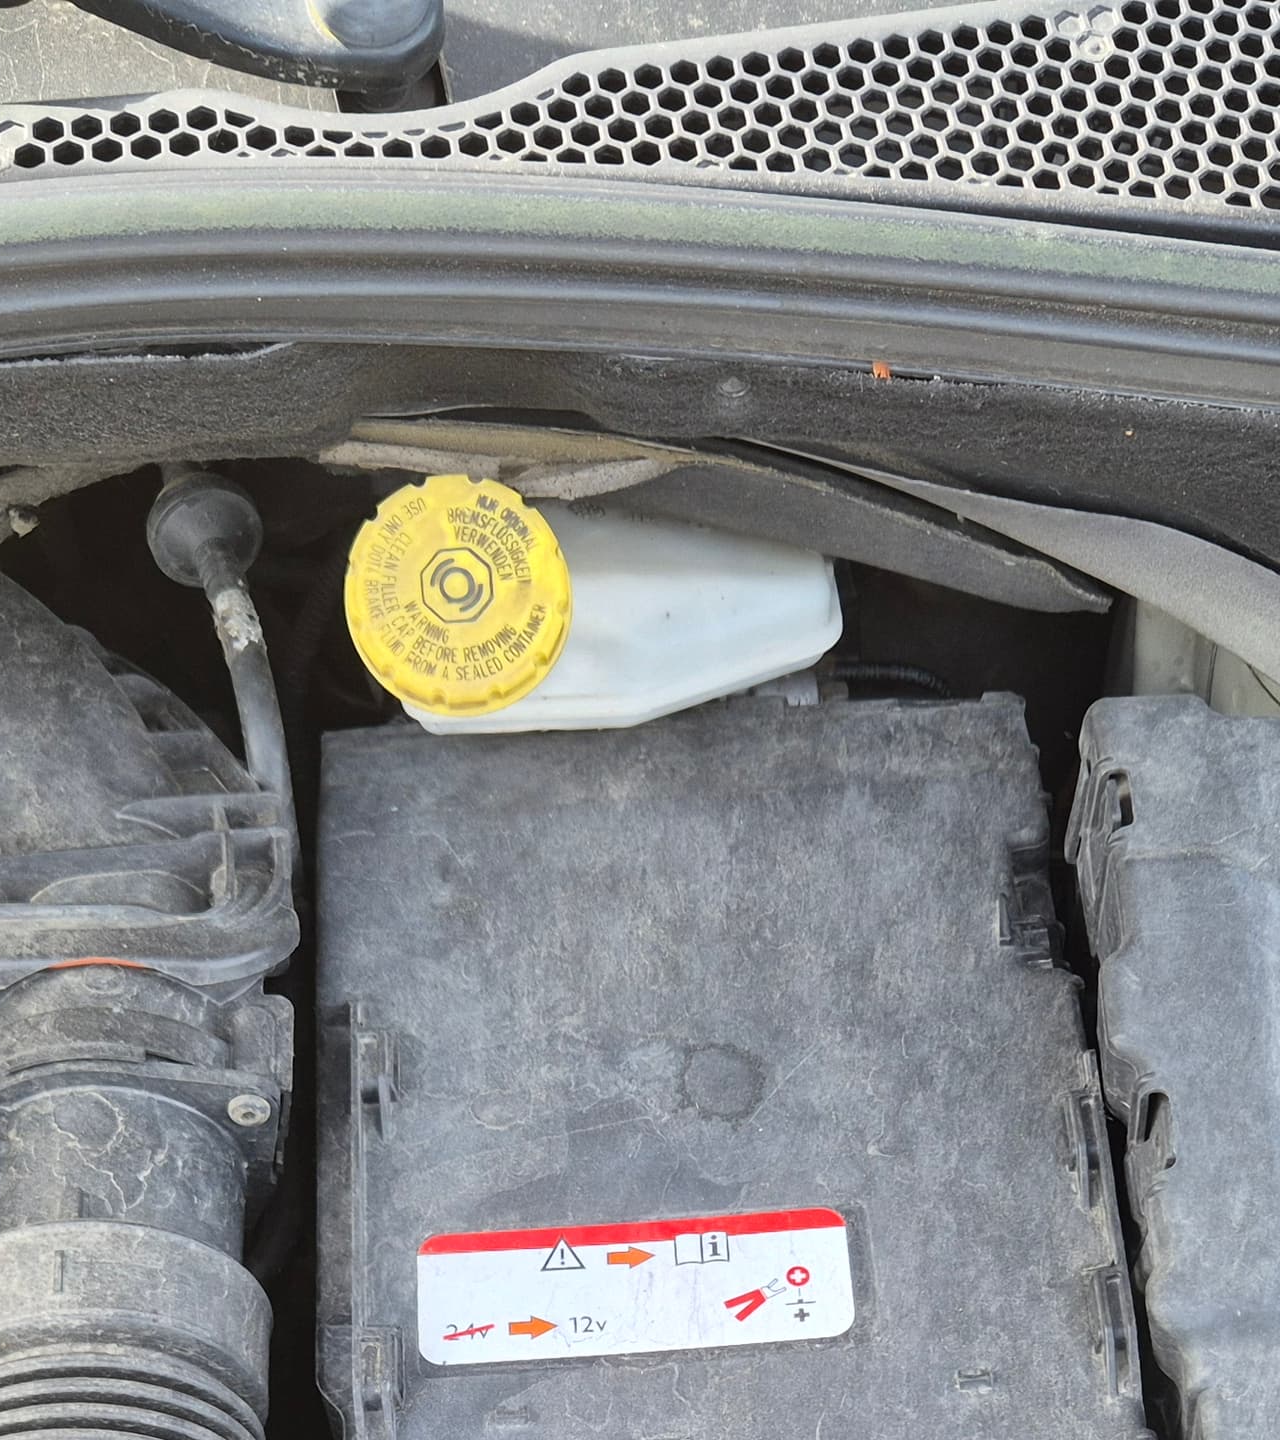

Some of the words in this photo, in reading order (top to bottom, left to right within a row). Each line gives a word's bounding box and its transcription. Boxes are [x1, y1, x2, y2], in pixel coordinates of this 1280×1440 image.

[402, 497, 426, 519] USE
[377, 514, 403, 544] ONLY
[383, 532, 411, 571] CLEAN
[453, 525, 512, 580] VERWENDEN
[381, 575, 400, 613] FILLER
[392, 615, 414, 638] CAP
[404, 600, 448, 644] WARNING
[503, 604, 545, 663] CONTAINER
[412, 635, 457, 663] BEFORE
[463, 624, 517, 662] REMOVING
[455, 656, 503, 679] SEALED
[569, 1315, 607, 1334] 12v
